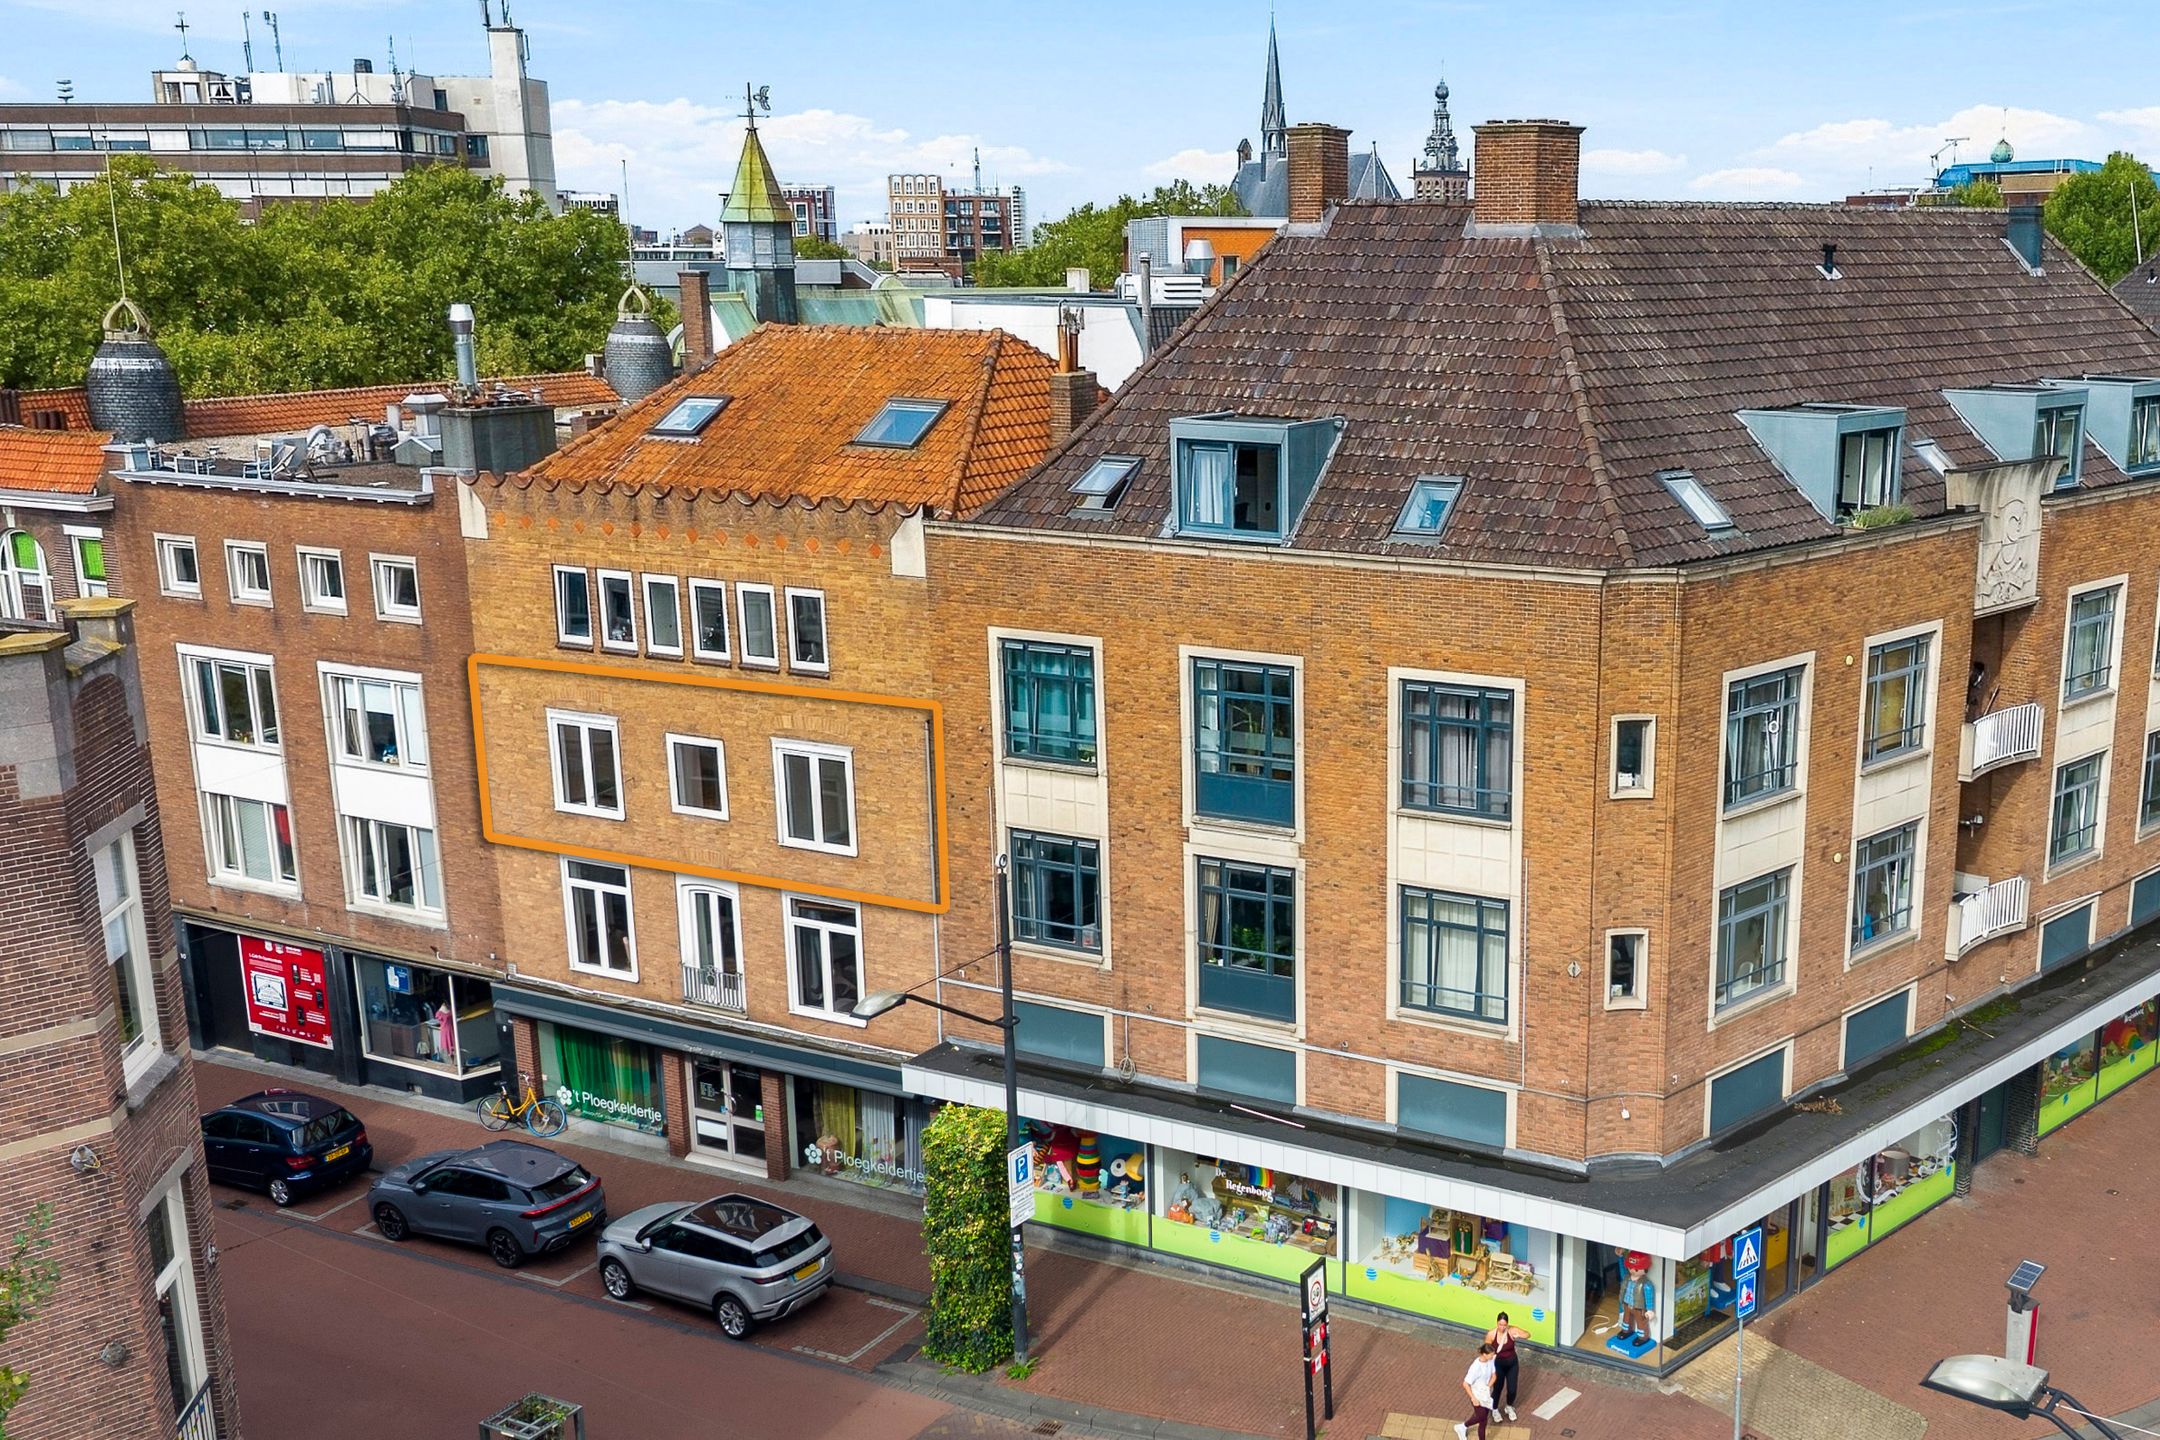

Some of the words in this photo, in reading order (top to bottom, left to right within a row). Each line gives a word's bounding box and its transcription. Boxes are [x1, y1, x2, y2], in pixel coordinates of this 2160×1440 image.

[572, 1089, 580, 1103] 't
[582, 1091, 662, 1123] Ploegkeldertje
[823, 1146, 831, 1162] 't
[834, 1150, 925, 1183] Ploegkeldertje
[1018, 1156, 1026, 1173] P
[1215, 1167, 1227, 1178] De
[1225, 1179, 1274, 1204] Regenboog
